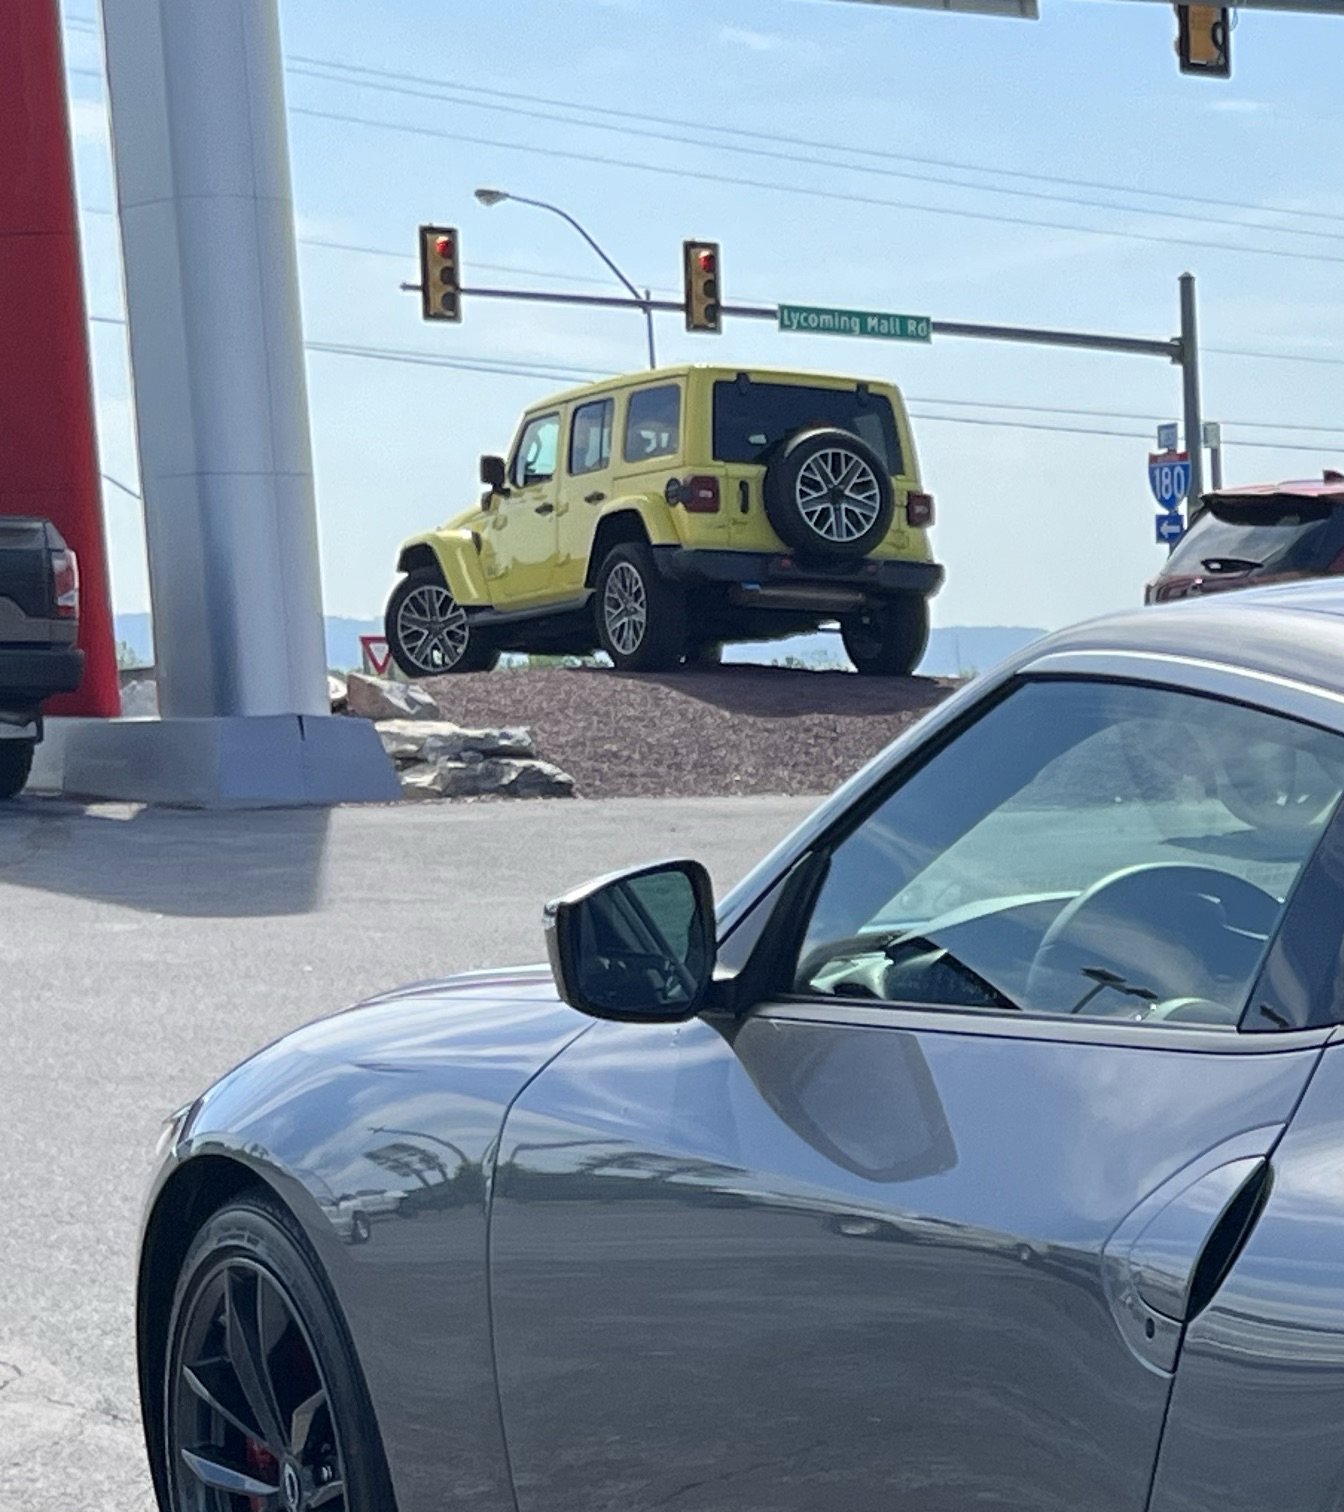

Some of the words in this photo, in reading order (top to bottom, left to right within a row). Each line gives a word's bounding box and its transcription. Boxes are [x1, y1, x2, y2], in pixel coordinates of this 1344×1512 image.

[783, 309, 860, 335] Lycoming
[866, 315, 901, 334] Mall
[907, 320, 927, 336] Rd
[1154, 466, 1185, 500] 180
